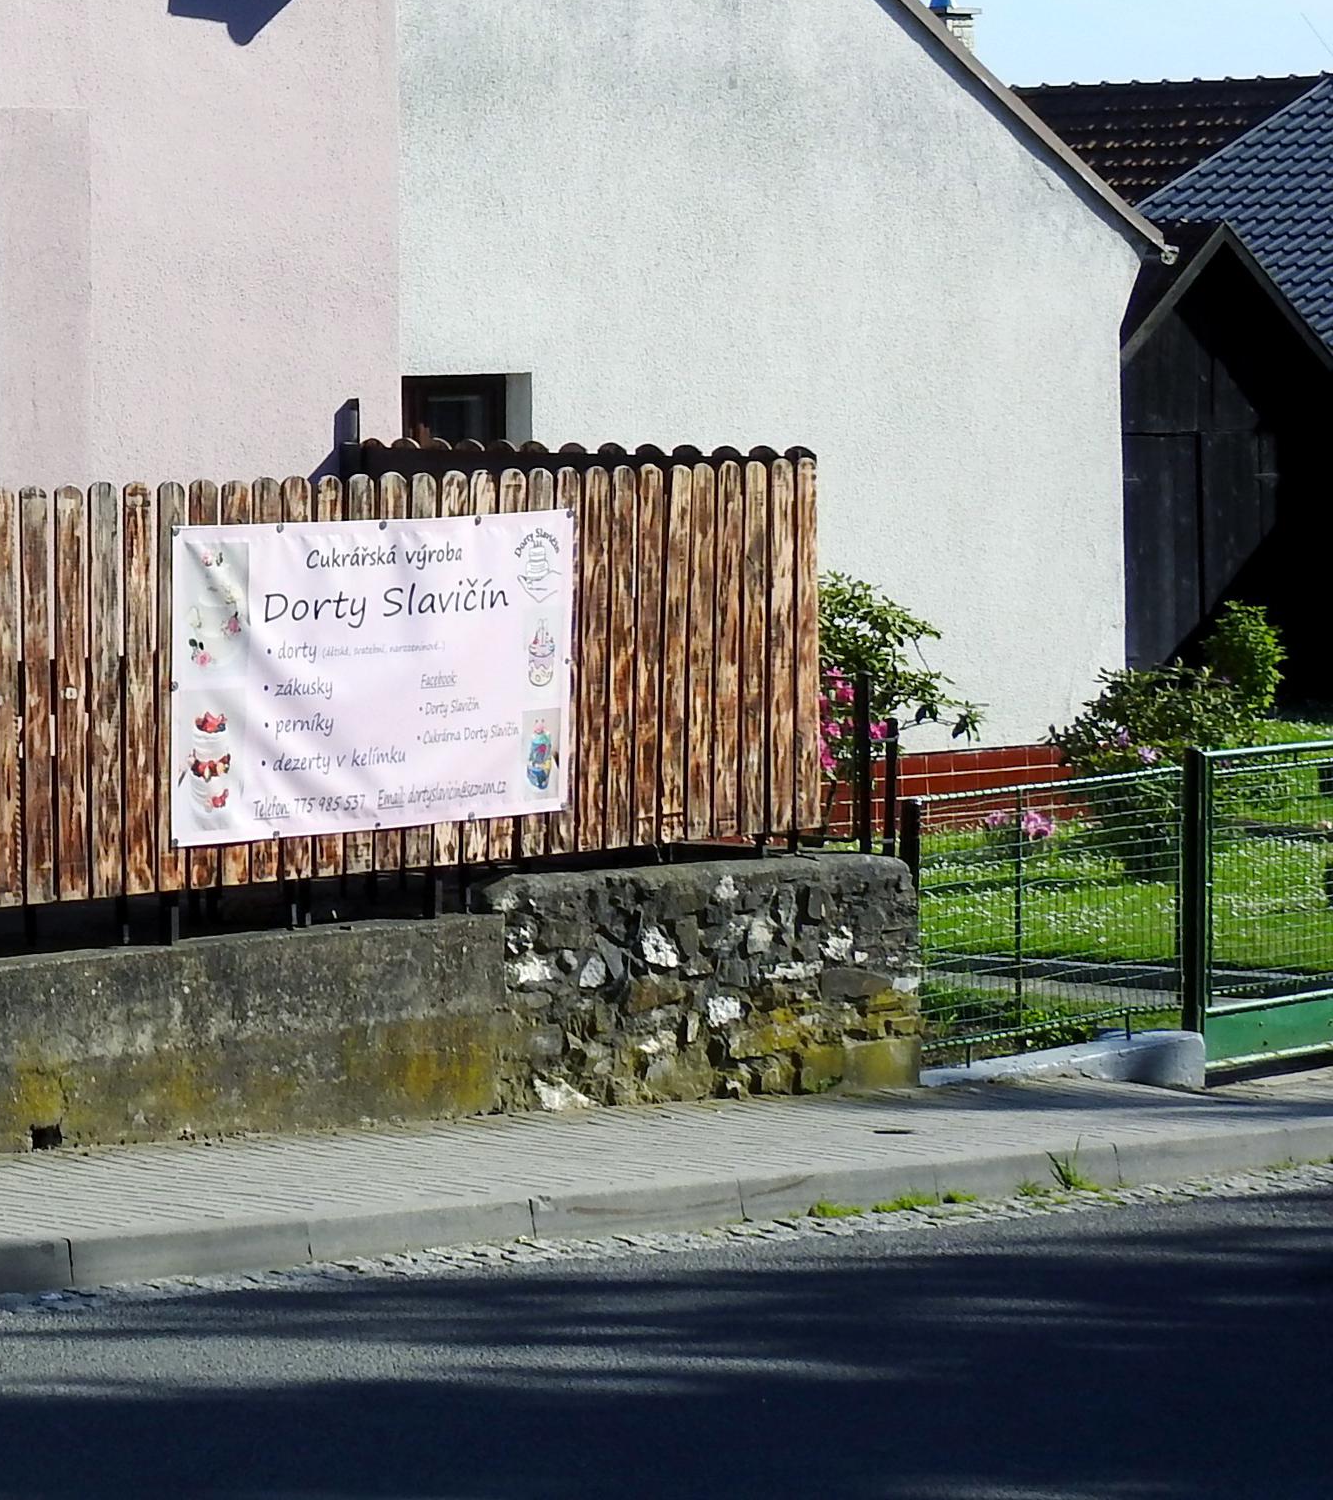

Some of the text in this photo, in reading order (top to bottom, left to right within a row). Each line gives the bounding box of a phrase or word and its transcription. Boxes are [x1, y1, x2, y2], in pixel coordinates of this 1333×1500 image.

[306, 541, 463, 570] Cukrářská výroba
[264, 578, 509, 629] Dorty Slavičín
[278, 641, 317, 663] dorty
[274, 677, 333, 700] zákusky
[425, 701, 449, 718] Dorty
[275, 712, 334, 740] perníky
[464, 727, 488, 744] Dorty
[272, 746, 406, 774] dezerty v kelímku
[294, 796, 314, 813] 775
[318, 795, 340, 812] 985
[342, 794, 365, 811] 537
